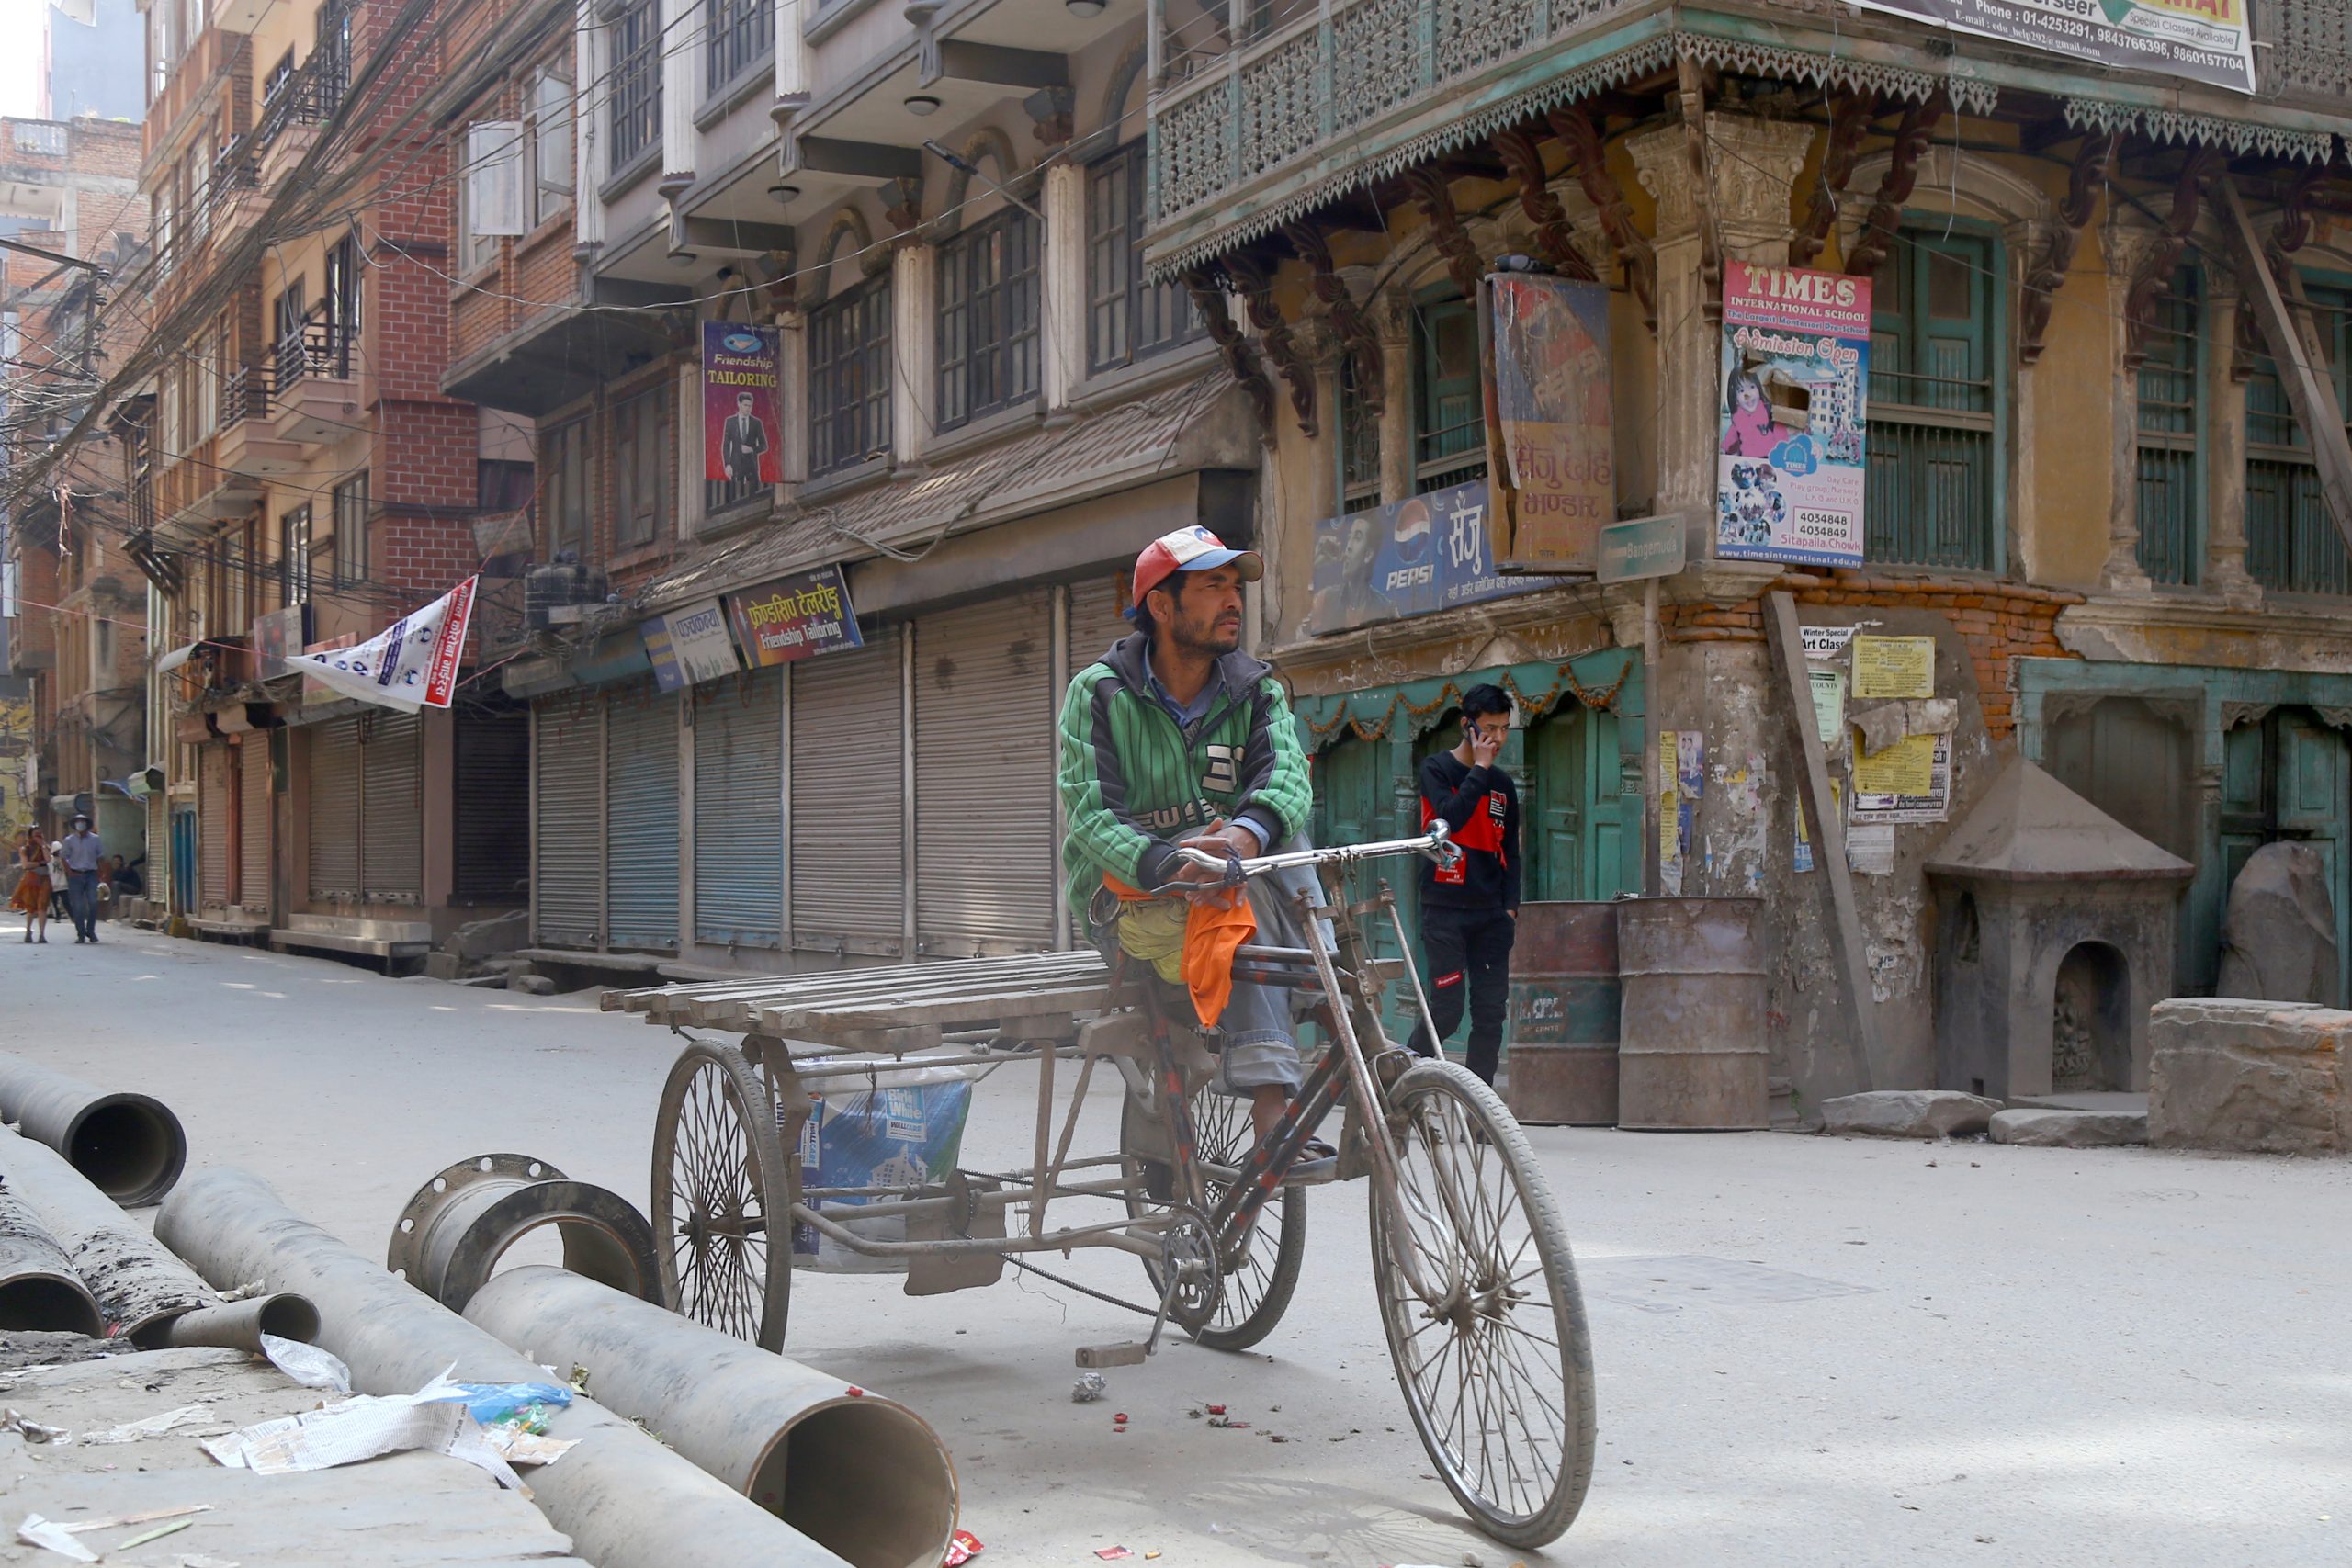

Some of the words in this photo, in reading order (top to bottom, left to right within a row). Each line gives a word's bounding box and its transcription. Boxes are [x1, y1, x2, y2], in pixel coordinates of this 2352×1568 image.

[1955, 10, 1984, 27] E-mail
[1976, 0, 2012, 19] Phone
[2022, 10, 2094, 41] 01-4253291,
[2098, 28, 2170, 59] 9843766396,
[2173, 46, 2245, 72] 9860157704
[2130, 12, 2160, 28] Special
[2162, 20, 2195, 36] Classes
[2196, 28, 2234, 45] Available
[1744, 265, 1855, 307] TIMES
[1731, 296, 1822, 318] INTERNATIONAL
[1825, 309, 1868, 322] SCHOOL
[1726, 310, 1742, 320] The
[1745, 313, 1776, 324] Largest
[1779, 317, 1822, 330] Montessori
[1734, 327, 1815, 356] Admission
[1816, 337, 1859, 367] Open
[714, 354, 774, 370] Friendship
[707, 369, 778, 387] TAILORING
[1790, 482, 1805, 491] Play
[1800, 513, 1848, 525] 4034848
[1800, 525, 1847, 538] 4034849
[1781, 533, 1826, 549] Sitapaila
[1828, 538, 1861, 552] Chowk
[1718, 550, 1863, 569] www.timesinternational.edu.np
[1385, 564, 1434, 591] PEPSI
[760, 626, 804, 649] Friendship
[801, 619, 842, 641] Tailoring
[1804, 628, 1825, 637] Winter
[1826, 628, 1849, 637] Special
[1802, 638, 1815, 650] Art
[888, 1101, 922, 1120] White
[808, 1122, 817, 1165] WALLCARE
